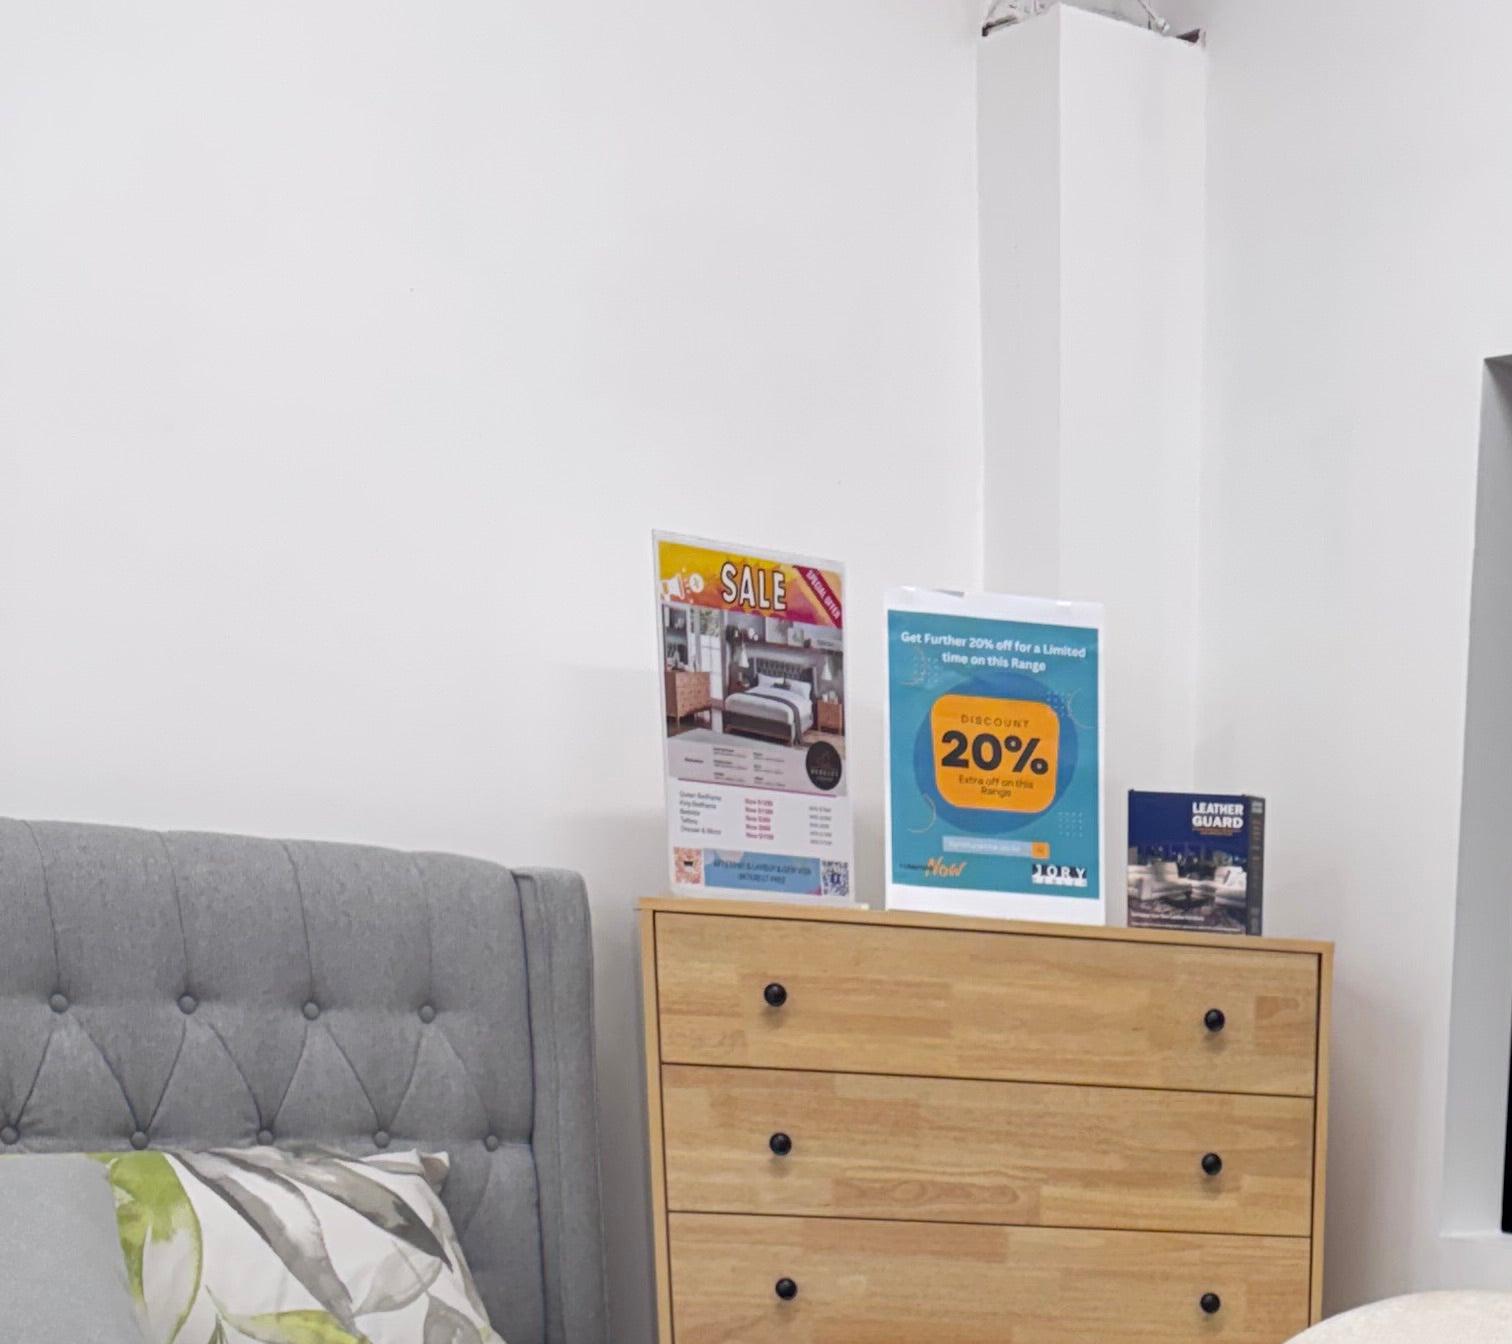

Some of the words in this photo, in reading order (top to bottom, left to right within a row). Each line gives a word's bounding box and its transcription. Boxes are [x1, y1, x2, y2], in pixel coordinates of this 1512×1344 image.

[720, 561, 787, 611] SALE
[901, 632, 921, 644] Get
[924, 633, 967, 647] Further
[968, 637, 994, 650] 20%
[996, 640, 1012, 651] off
[1014, 641, 1031, 653] for
[1033, 645, 1041, 654] a
[1043, 643, 1086, 658] Limited
[942, 652, 968, 664] time
[970, 656, 985, 665] on
[987, 655, 1009, 668] this
[1011, 658, 1046, 673] Range
[960, 714, 1029, 728] DISCOUNT
[941, 730, 1049, 775] 20%
[1192, 802, 1244, 816] LEATHER
[1192, 815, 1244, 829] GUARD
[1033, 864, 1087, 879] JORY
